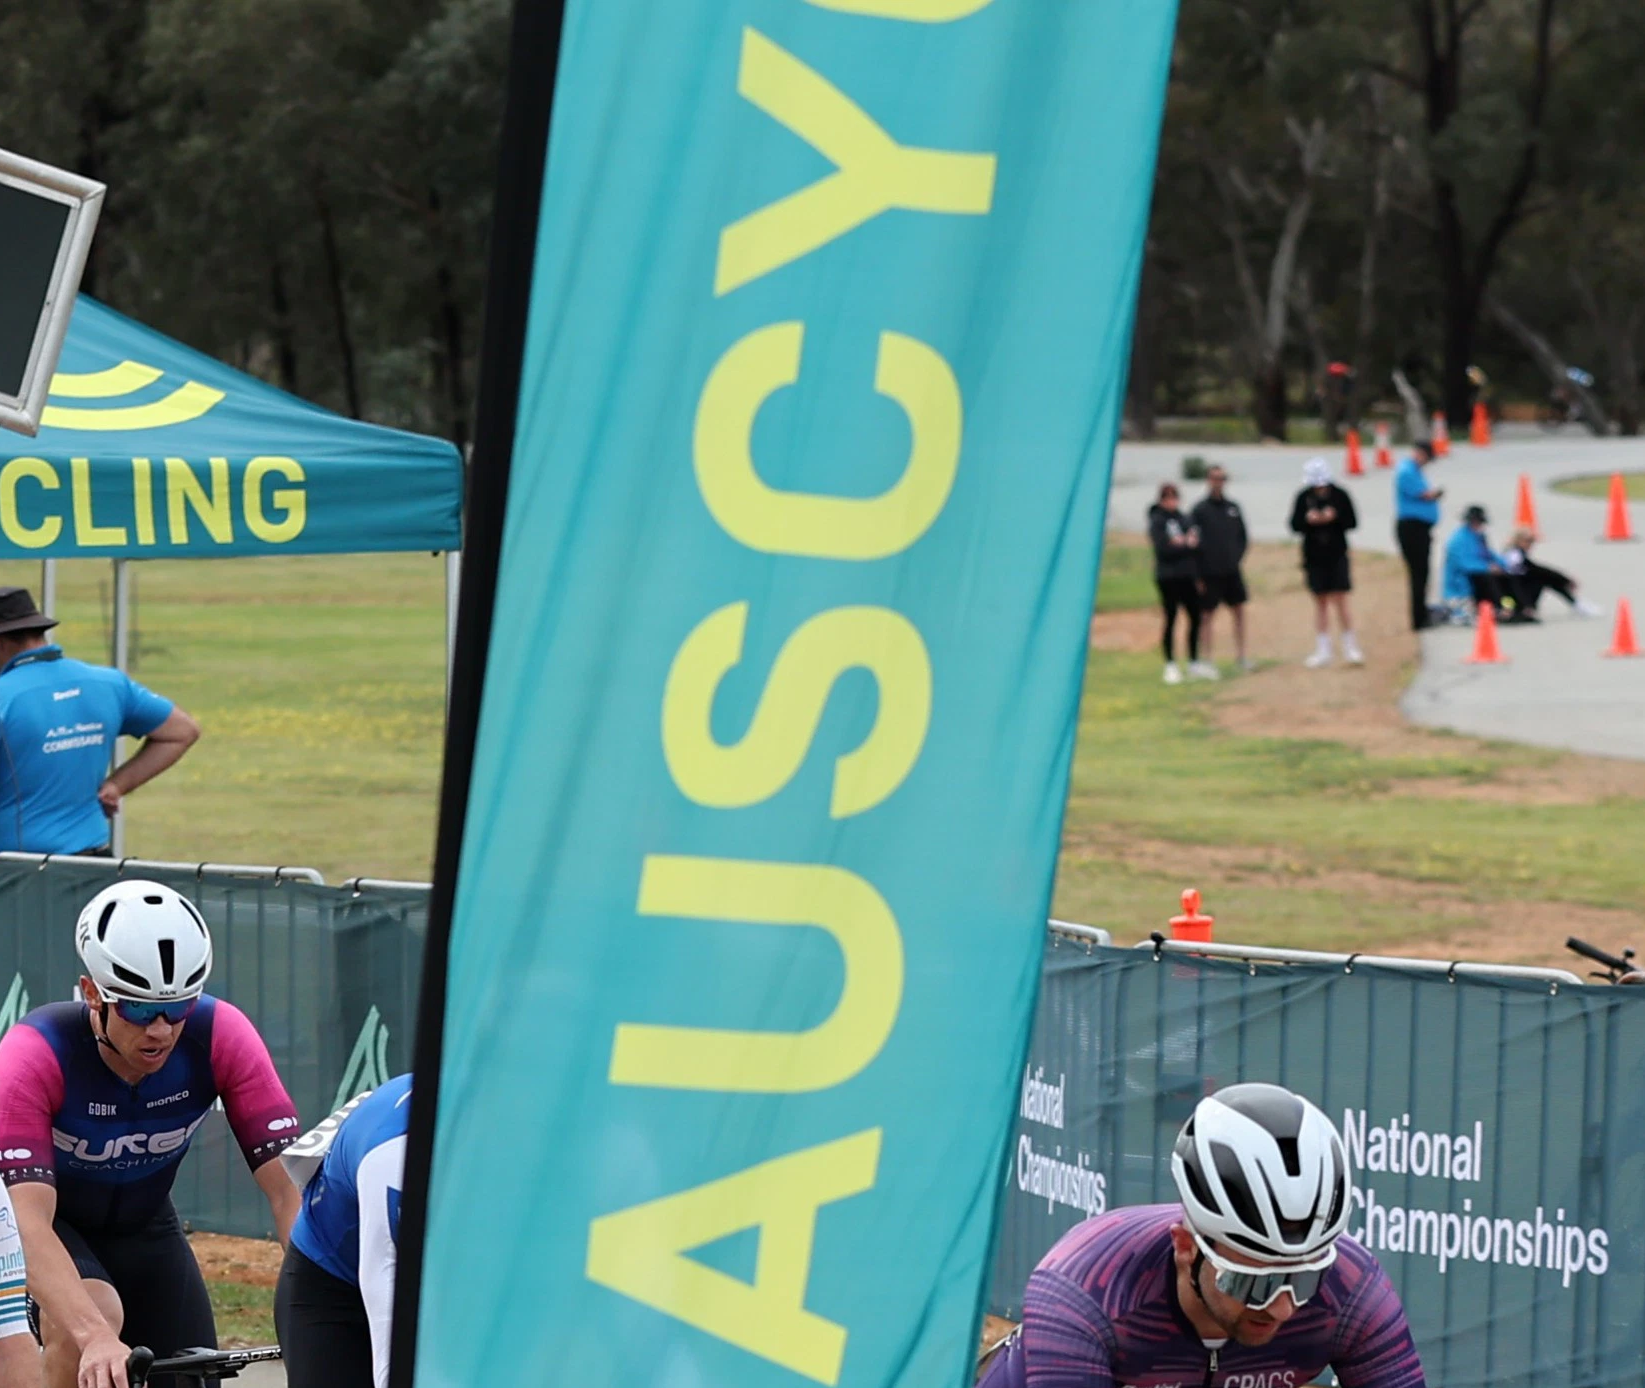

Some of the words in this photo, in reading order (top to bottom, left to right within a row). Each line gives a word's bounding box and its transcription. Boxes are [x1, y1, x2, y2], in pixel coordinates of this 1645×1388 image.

[585, 0, 997, 1387] AUSCY
[89, 1102, 117, 1115] GOBIK
[146, 1090, 189, 1109] BIONICO
[1017, 1133, 1107, 1221] Championships
[1343, 1107, 1482, 1182] National
[1348, 1185, 1609, 1288] Championships
[229, 1348, 282, 1361] CADEX
